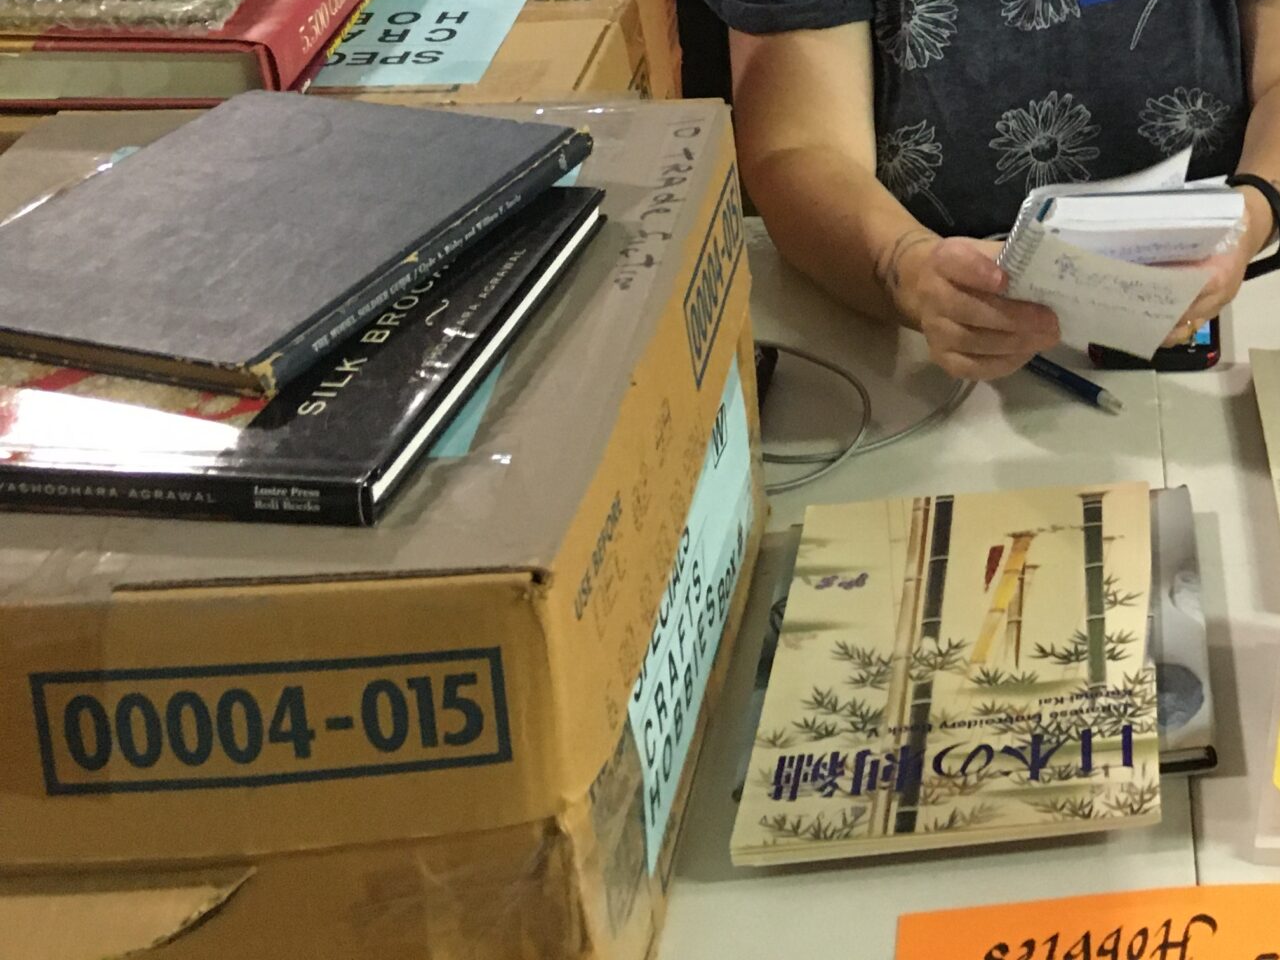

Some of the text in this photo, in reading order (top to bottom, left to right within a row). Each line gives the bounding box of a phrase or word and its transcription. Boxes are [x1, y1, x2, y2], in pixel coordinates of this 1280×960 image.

[389, 273, 413, 295] GUIDE
[478, 248, 528, 300] AGRAWAL
[297, 354, 369, 417] SILK
[128, 488, 218, 504] AGRAWAL
[253, 485, 321, 499] Lustre Press
[282, 500, 322, 513] Books
[573, 571, 594, 621] USE
[643, 558, 702, 770] CRAFTS
[61, 672, 486, 774] 00004-015
[647, 583, 716, 827] HOBBIES
